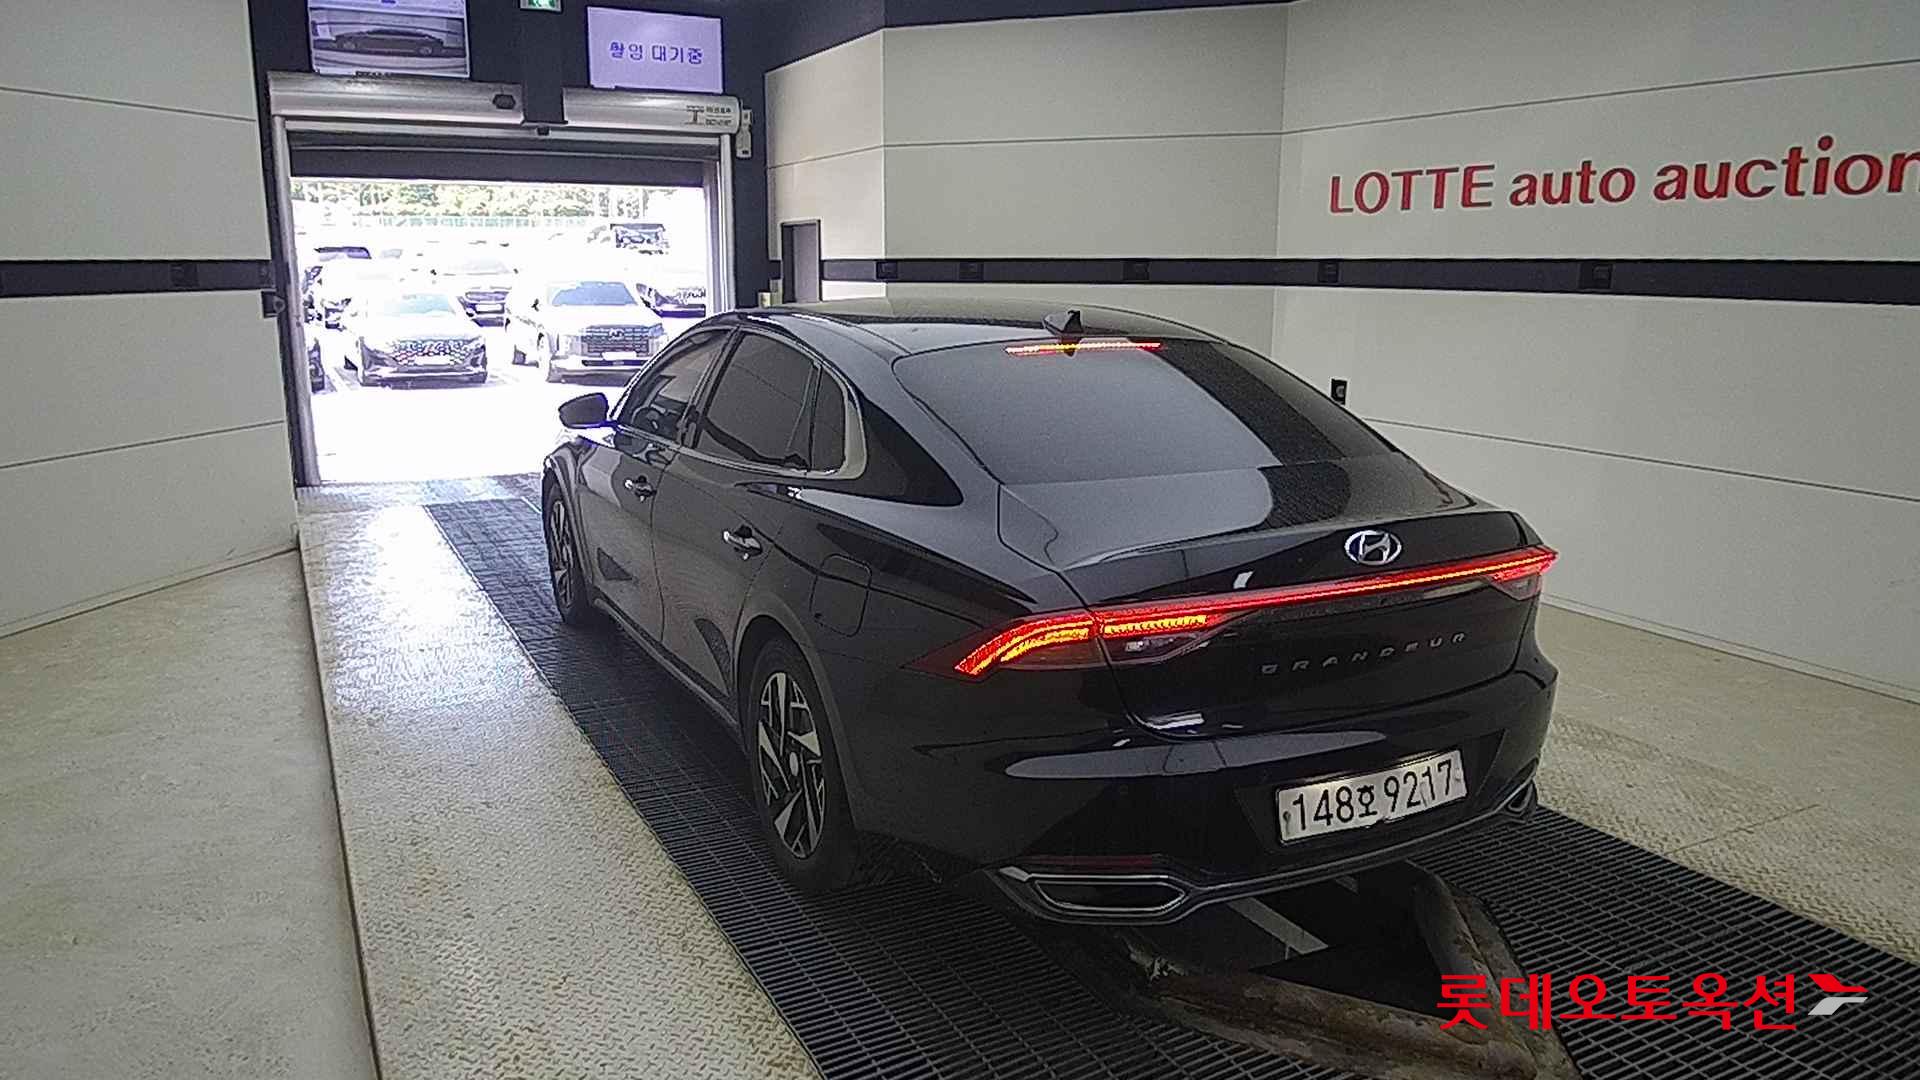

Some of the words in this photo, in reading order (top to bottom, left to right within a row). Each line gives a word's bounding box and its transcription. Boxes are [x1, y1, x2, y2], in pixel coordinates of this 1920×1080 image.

[651, 44, 703, 65] 대기중
[1329, 163, 1496, 214] LOTTE
[1509, 159, 1636, 207] auto
[1260, 631, 1468, 675] GRANDEUR
[1383, 758, 1453, 813] 9217
